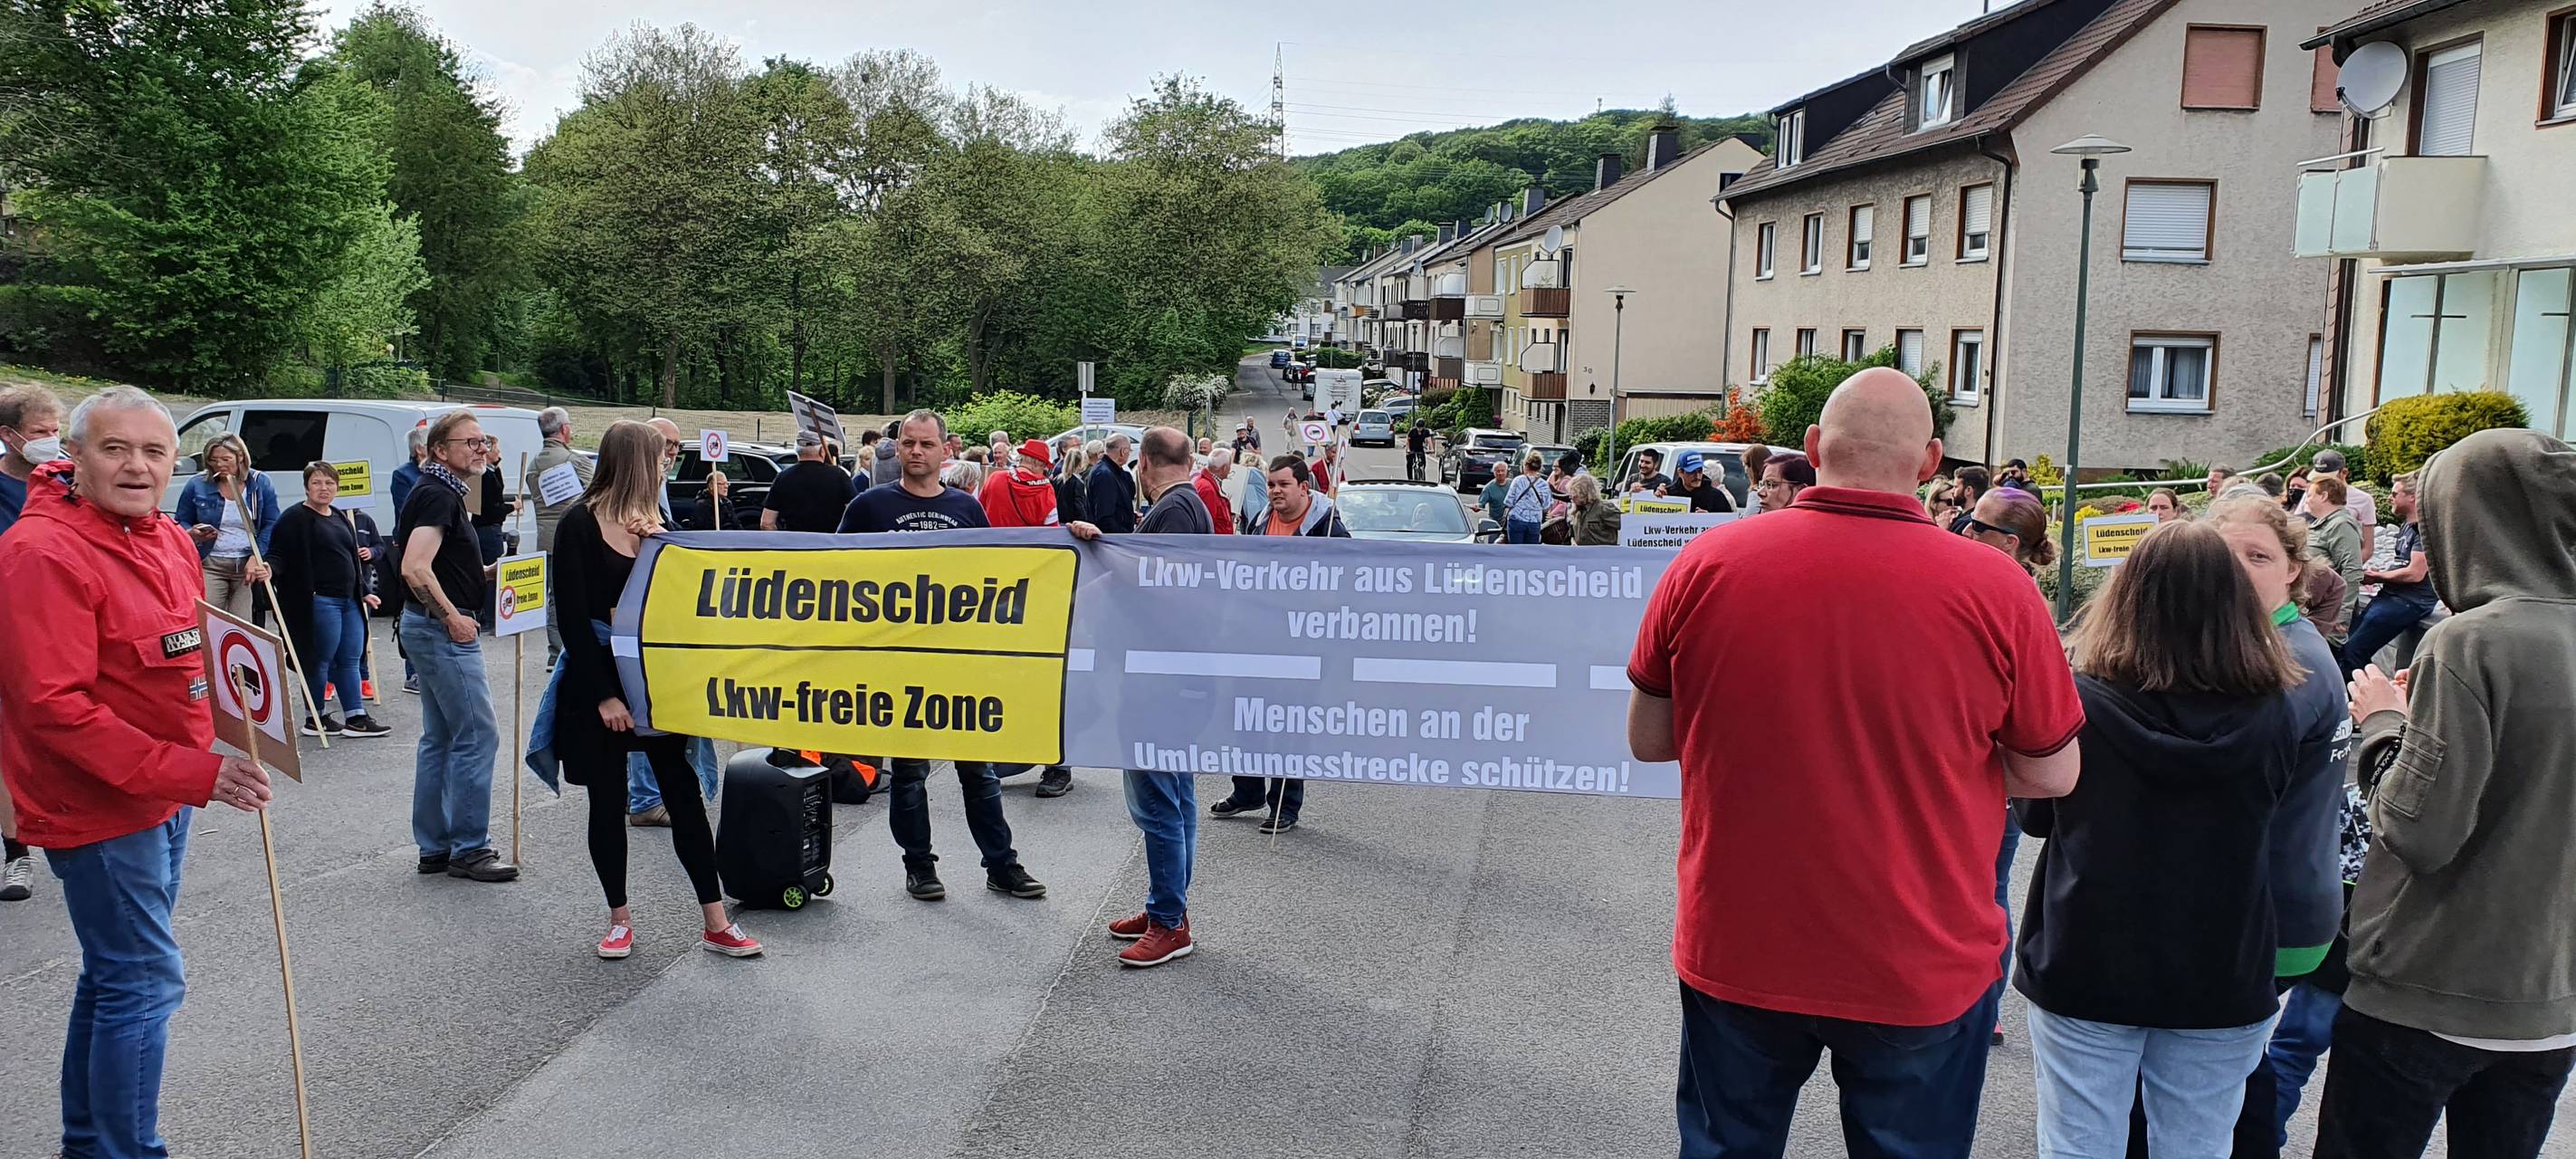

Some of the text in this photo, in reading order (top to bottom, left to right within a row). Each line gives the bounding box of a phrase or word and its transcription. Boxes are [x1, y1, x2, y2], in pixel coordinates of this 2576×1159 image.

[338, 465, 364, 475] nscheid
[896, 512, 926, 524] AUTHENTIC
[920, 521, 938, 530] 1982
[1644, 525, 1698, 534] Lkw-Verkehr
[1627, 538, 1682, 547] Lüdenscheid
[506, 564, 540, 582] Lüdenscheid
[1138, 556, 1643, 599] Lkw-Verkehr aus Lüdenscheid
[696, 568, 1029, 625] Lüdenscheid
[1287, 606, 1477, 643] verbannen!
[707, 676, 1003, 732] Lkw-freie Zone
[1234, 696, 1531, 742] Menschen an der
[1134, 742, 1630, 792] Umleitungsstrecke schützen!
